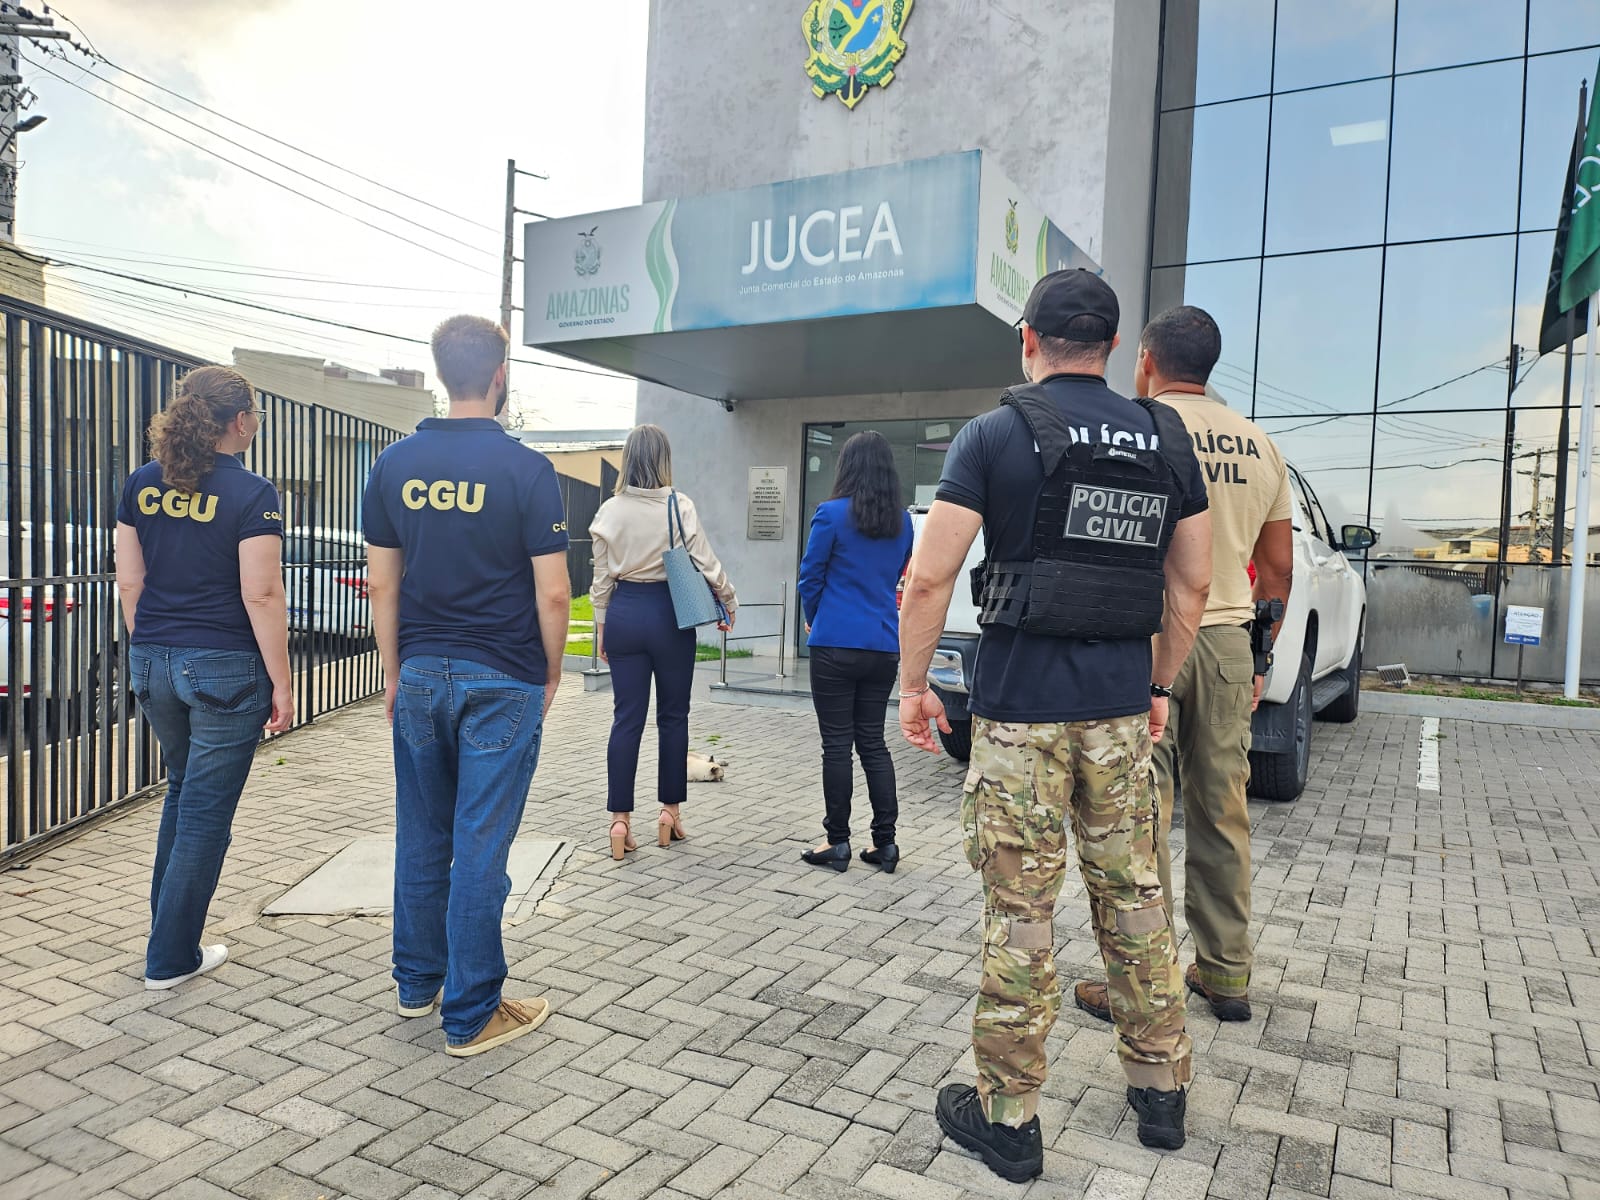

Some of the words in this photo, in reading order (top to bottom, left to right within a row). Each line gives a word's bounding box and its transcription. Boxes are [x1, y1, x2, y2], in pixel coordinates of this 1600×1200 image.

[741, 201, 904, 275] JUCEA
[739, 285, 760, 296] Junta
[761, 279, 800, 293] Comercial
[802, 278, 812, 288] do
[813, 275, 844, 287] Estado
[845, 272, 856, 282] do
[857, 268, 904, 281] Amazonas
[991, 252, 1030, 304] AMAZONAS
[546, 284, 630, 321] AMAZONAS
[558, 320, 584, 328] GOVERNO
[593, 317, 615, 325] ESTADO
[1191, 429, 1261, 460] LÍCIA
[1200, 460, 1248, 484] VIL
[137, 486, 219, 523] CGU
[401, 479, 486, 513] CGU
[1073, 488, 1162, 520] POLÍCIA
[552, 521, 567, 533] CG
[1086, 515, 1147, 542] CIVIL
